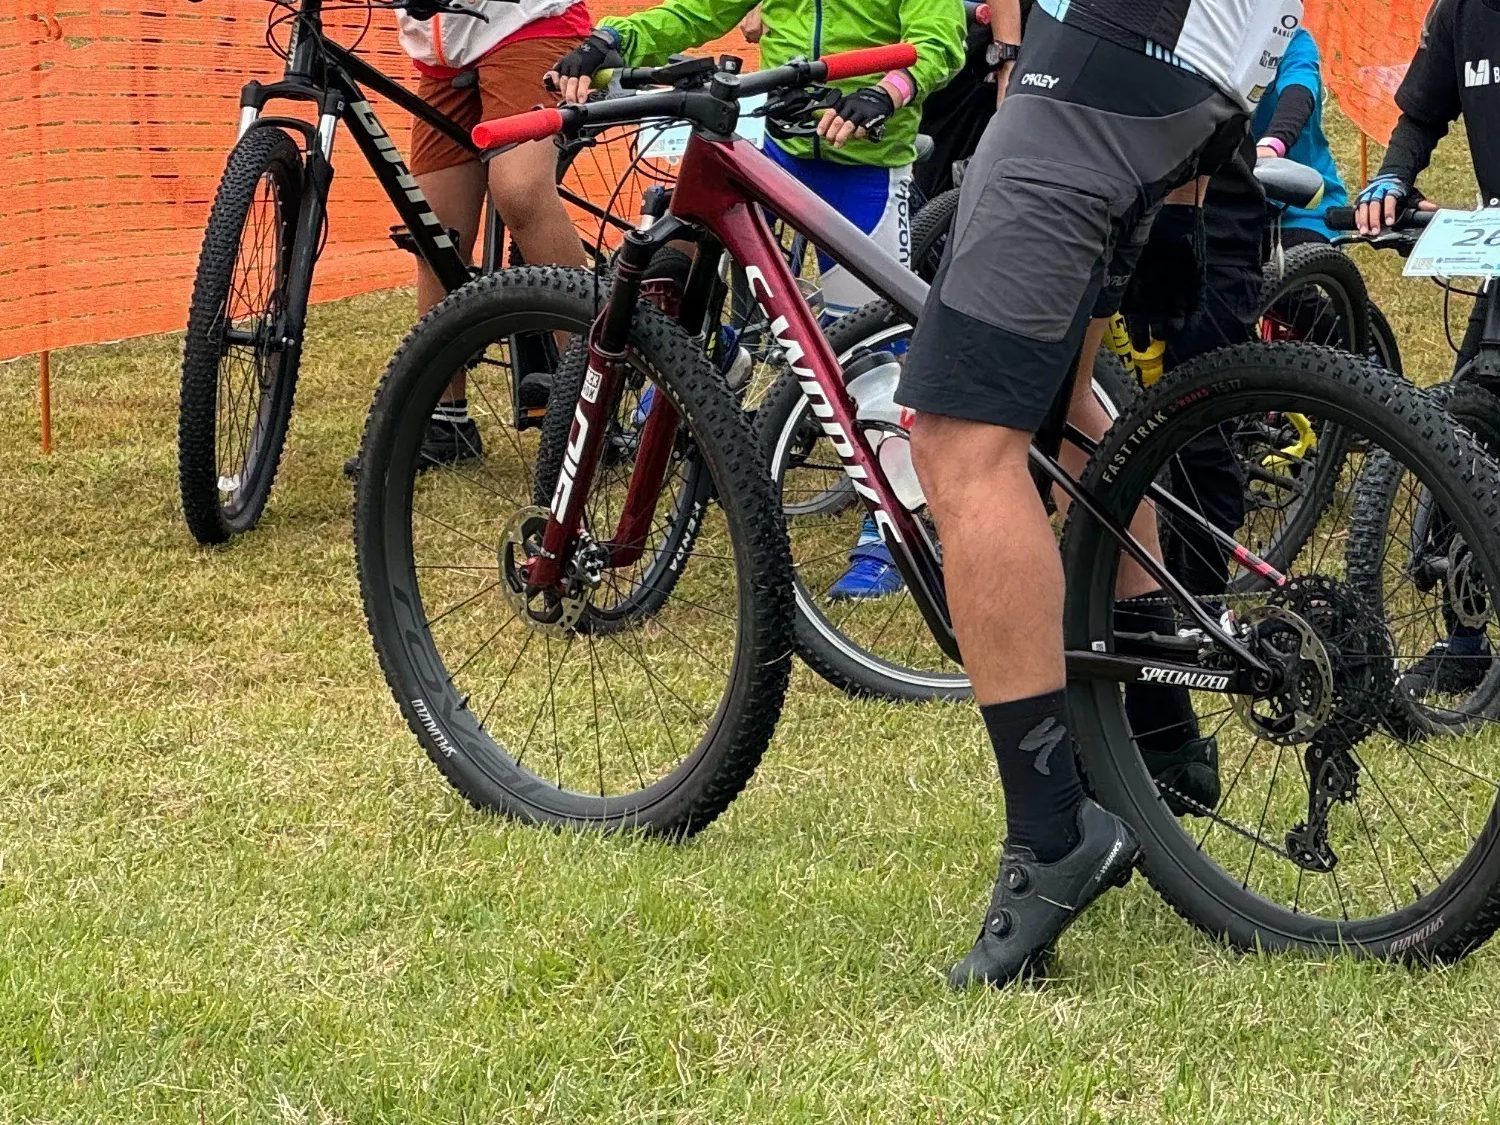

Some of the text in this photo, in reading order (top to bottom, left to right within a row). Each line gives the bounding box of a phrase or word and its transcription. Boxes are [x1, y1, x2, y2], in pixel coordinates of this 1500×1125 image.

[1021, 73, 1060, 89] OAKLEY
[1102, 410, 1168, 484] FAST TRAK
[669, 501, 701, 572] KENDA
[1137, 666, 1230, 690] SPECIALIZED
